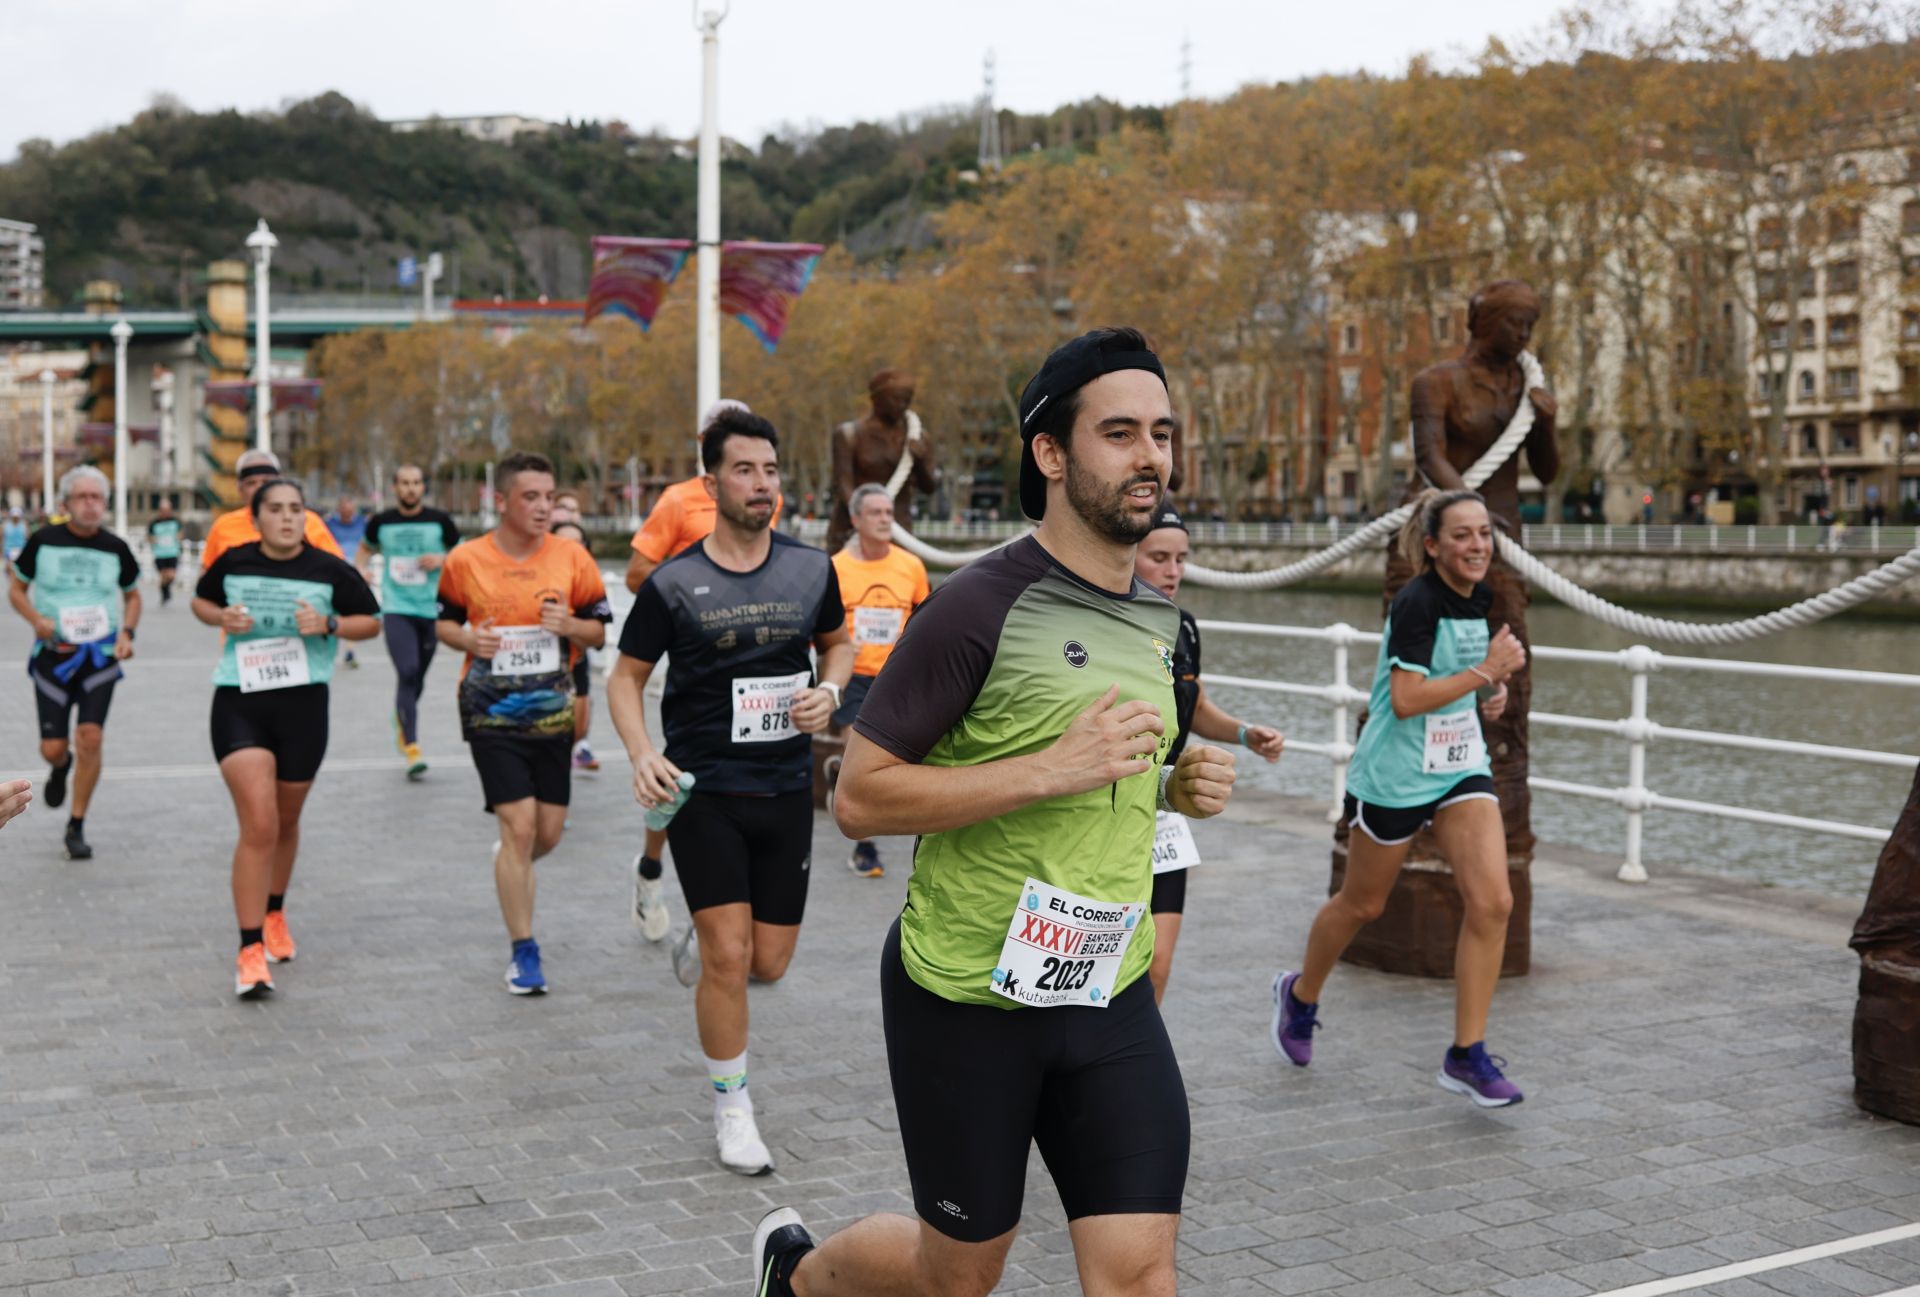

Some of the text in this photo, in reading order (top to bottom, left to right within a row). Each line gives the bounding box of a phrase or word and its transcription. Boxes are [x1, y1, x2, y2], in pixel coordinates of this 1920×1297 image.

[762, 711, 789, 731] 878
[1447, 744, 1468, 762] 827
[1049, 897, 1123, 923] EL CORREO
[1018, 914, 1084, 955] XXXVI
[1086, 932, 1125, 943] SANTURCE
[1081, 942, 1118, 955] BILBAO
[1035, 957, 1095, 991] 2023
[1018, 986, 1067, 1004] kutxabank
